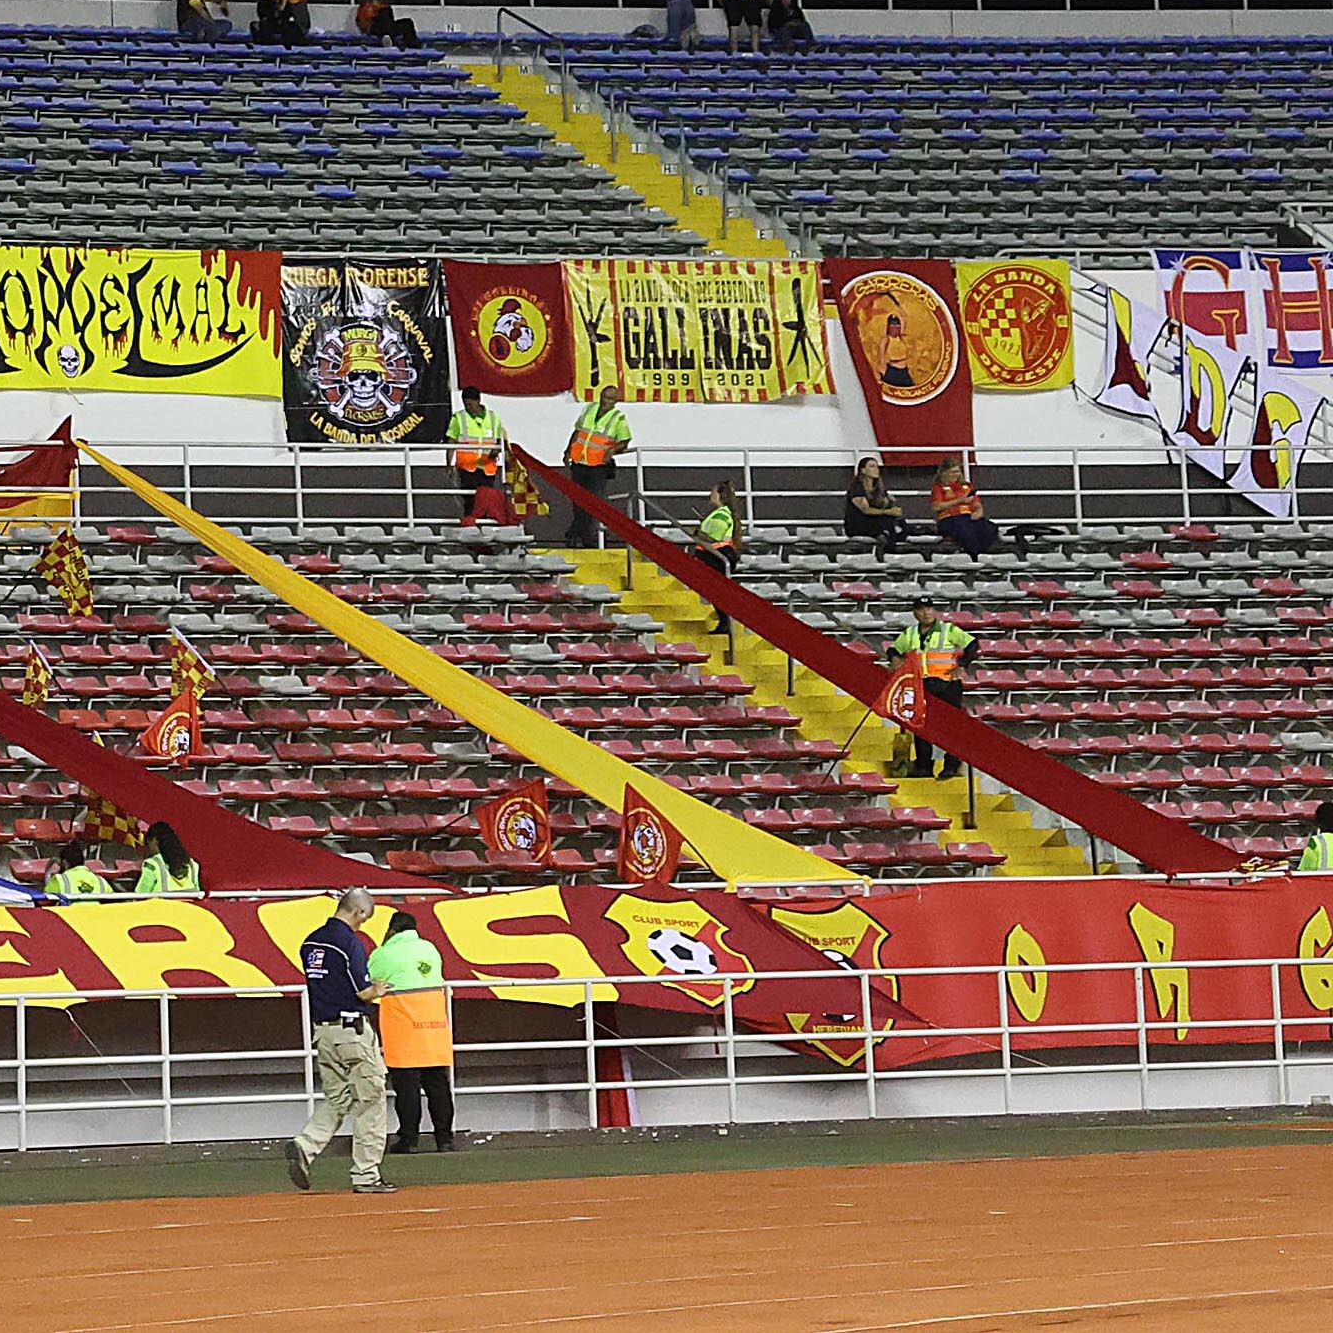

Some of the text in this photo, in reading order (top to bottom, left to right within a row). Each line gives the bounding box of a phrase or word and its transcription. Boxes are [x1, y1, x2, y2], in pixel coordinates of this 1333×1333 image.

[622, 306, 774, 372] GALLINAS
[632, 914, 701, 930] CLUB SPORT
[821, 935, 857, 948] SPORT
